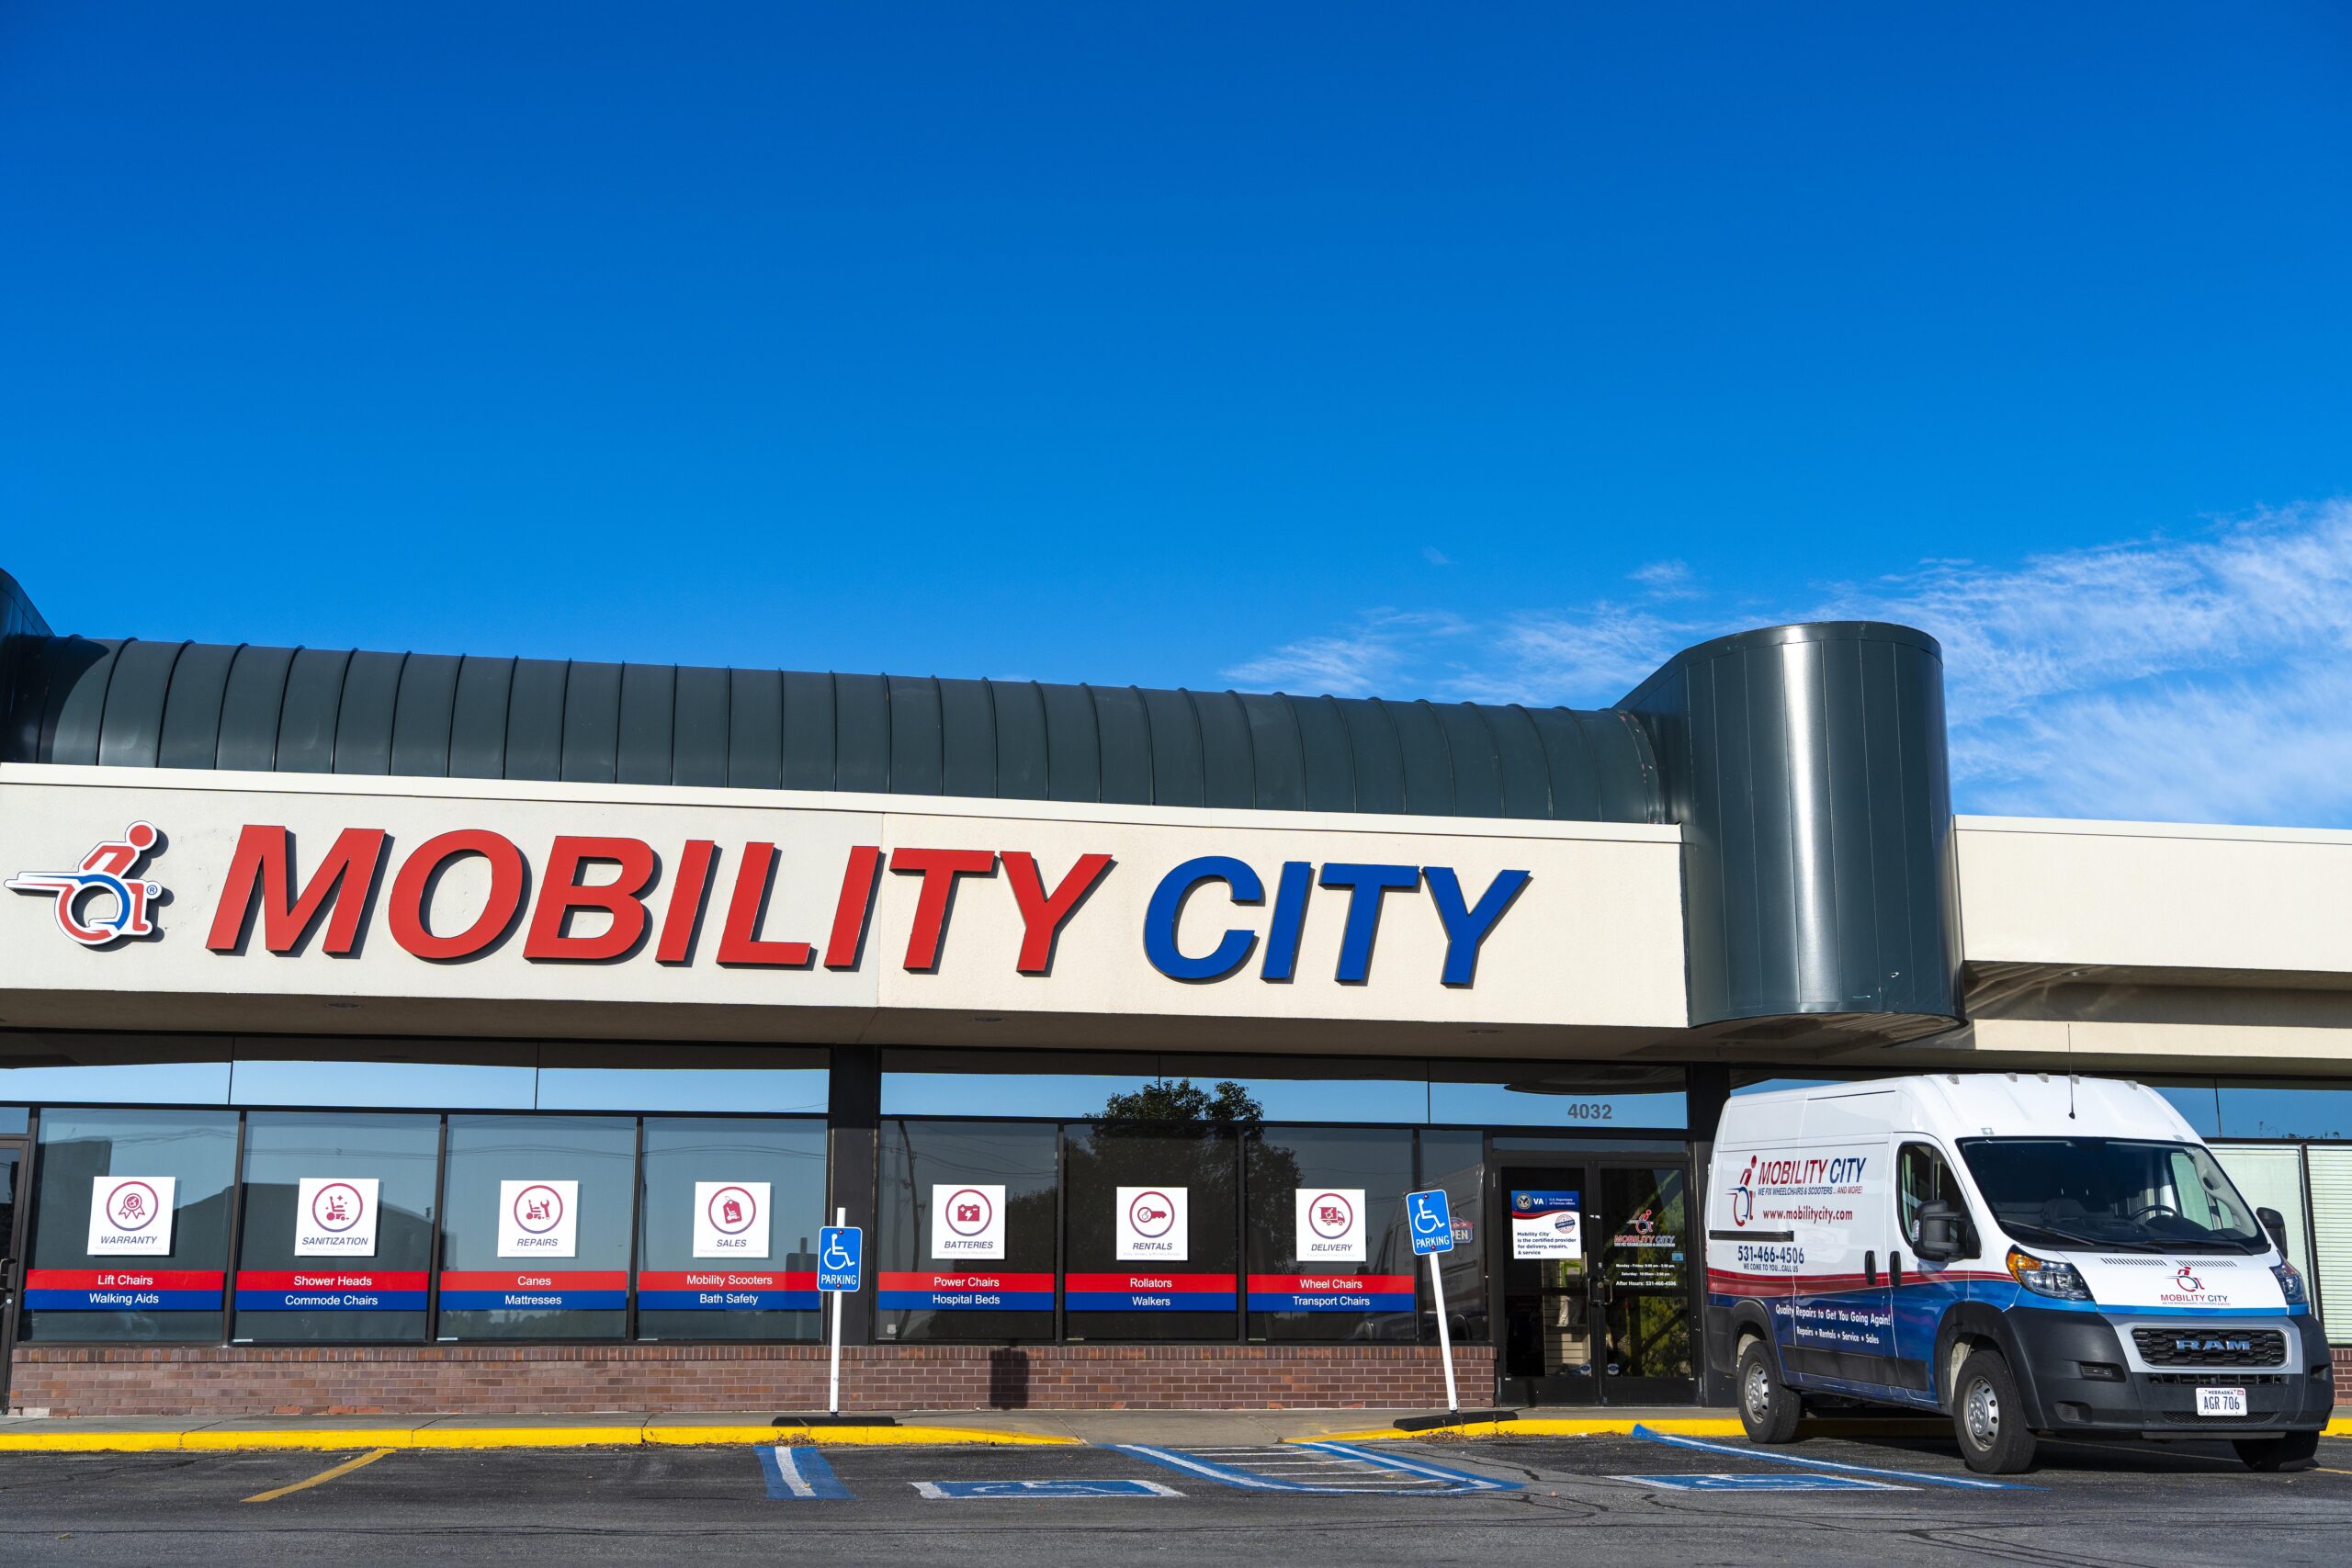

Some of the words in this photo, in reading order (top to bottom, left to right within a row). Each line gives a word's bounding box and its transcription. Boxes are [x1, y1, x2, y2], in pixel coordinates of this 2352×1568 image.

[206, 823, 1114, 976] MOBILITY
[1143, 855, 1532, 987] CITY
[1567, 1103, 1612, 1119] 4032
[1758, 1158, 1829, 1185] MOBILITY
[1829, 1157, 1867, 1184] CITY
[1772, 1187, 1804, 1195] WHEELCHAIRS
[1848, 1185, 1863, 1194] MORE!
[1763, 1205, 1853, 1224] www.mobilitycity.com
[100, 1235, 158, 1244] WARRANTY
[301, 1236, 368, 1245] SANITIZATION
[516, 1238, 559, 1247] REPAIRS
[716, 1239, 747, 1247] SALES
[944, 1240, 994, 1248] BATTERIES
[1416, 1235, 1450, 1248] PARKING
[1614, 1235, 1655, 1243] MOBILITY
[1656, 1235, 1676, 1243] CITY
[1132, 1242, 1173, 1250] RENTALS
[1737, 1245, 1804, 1264] 531-466-4506
[97, 1274, 115, 1285] Lift
[118, 1274, 153, 1285] Chairs
[294, 1276, 335, 1286] Shower
[337, 1276, 372, 1286] Heads
[517, 1275, 551, 1286] Canes
[686, 1274, 725, 1287] Mobility
[728, 1274, 773, 1285] Scooters
[820, 1274, 857, 1285] PARKING
[933, 1277, 966, 1287] Power
[967, 1277, 1000, 1287] Chairs
[1129, 1278, 1172, 1288] Rollators
[1299, 1279, 1329, 1289] Wheel
[1332, 1279, 1363, 1289] Chairs
[89, 1292, 132, 1305] Walking
[134, 1292, 159, 1303] Aids
[285, 1294, 341, 1305] Commode
[344, 1294, 379, 1305] Chairs
[504, 1294, 562, 1305] Mattresses
[699, 1293, 723, 1303] Bath
[726, 1293, 759, 1305] Safety
[933, 1294, 972, 1306] Hospital
[975, 1294, 1001, 1304] Beds
[1132, 1296, 1170, 1306] Walkers
[1293, 1295, 1337, 1307] Transport
[1340, 1296, 1370, 1306] Chairs
[2160, 1293, 2205, 1302] MOBILITY
[1775, 1304, 1793, 1318] Quality
[1795, 1306, 1816, 1319] Repairs
[1818, 1309, 1824, 1318] to
[1826, 1309, 1837, 1320] Get
[1838, 1310, 1849, 1321] You
[1850, 1312, 1869, 1325] Going
[1870, 1313, 1891, 1326] Again!
[1796, 1325, 1814, 1337] Repairs
[1819, 1328, 1837, 1339] Rentals
[1841, 1331, 1860, 1342] Service
[1865, 1334, 1880, 1344] Sales
[2176, 1339, 2250, 1350] RAM
[2204, 1396, 2221, 1410] AGR
[2223, 1396, 2240, 1410] 706
